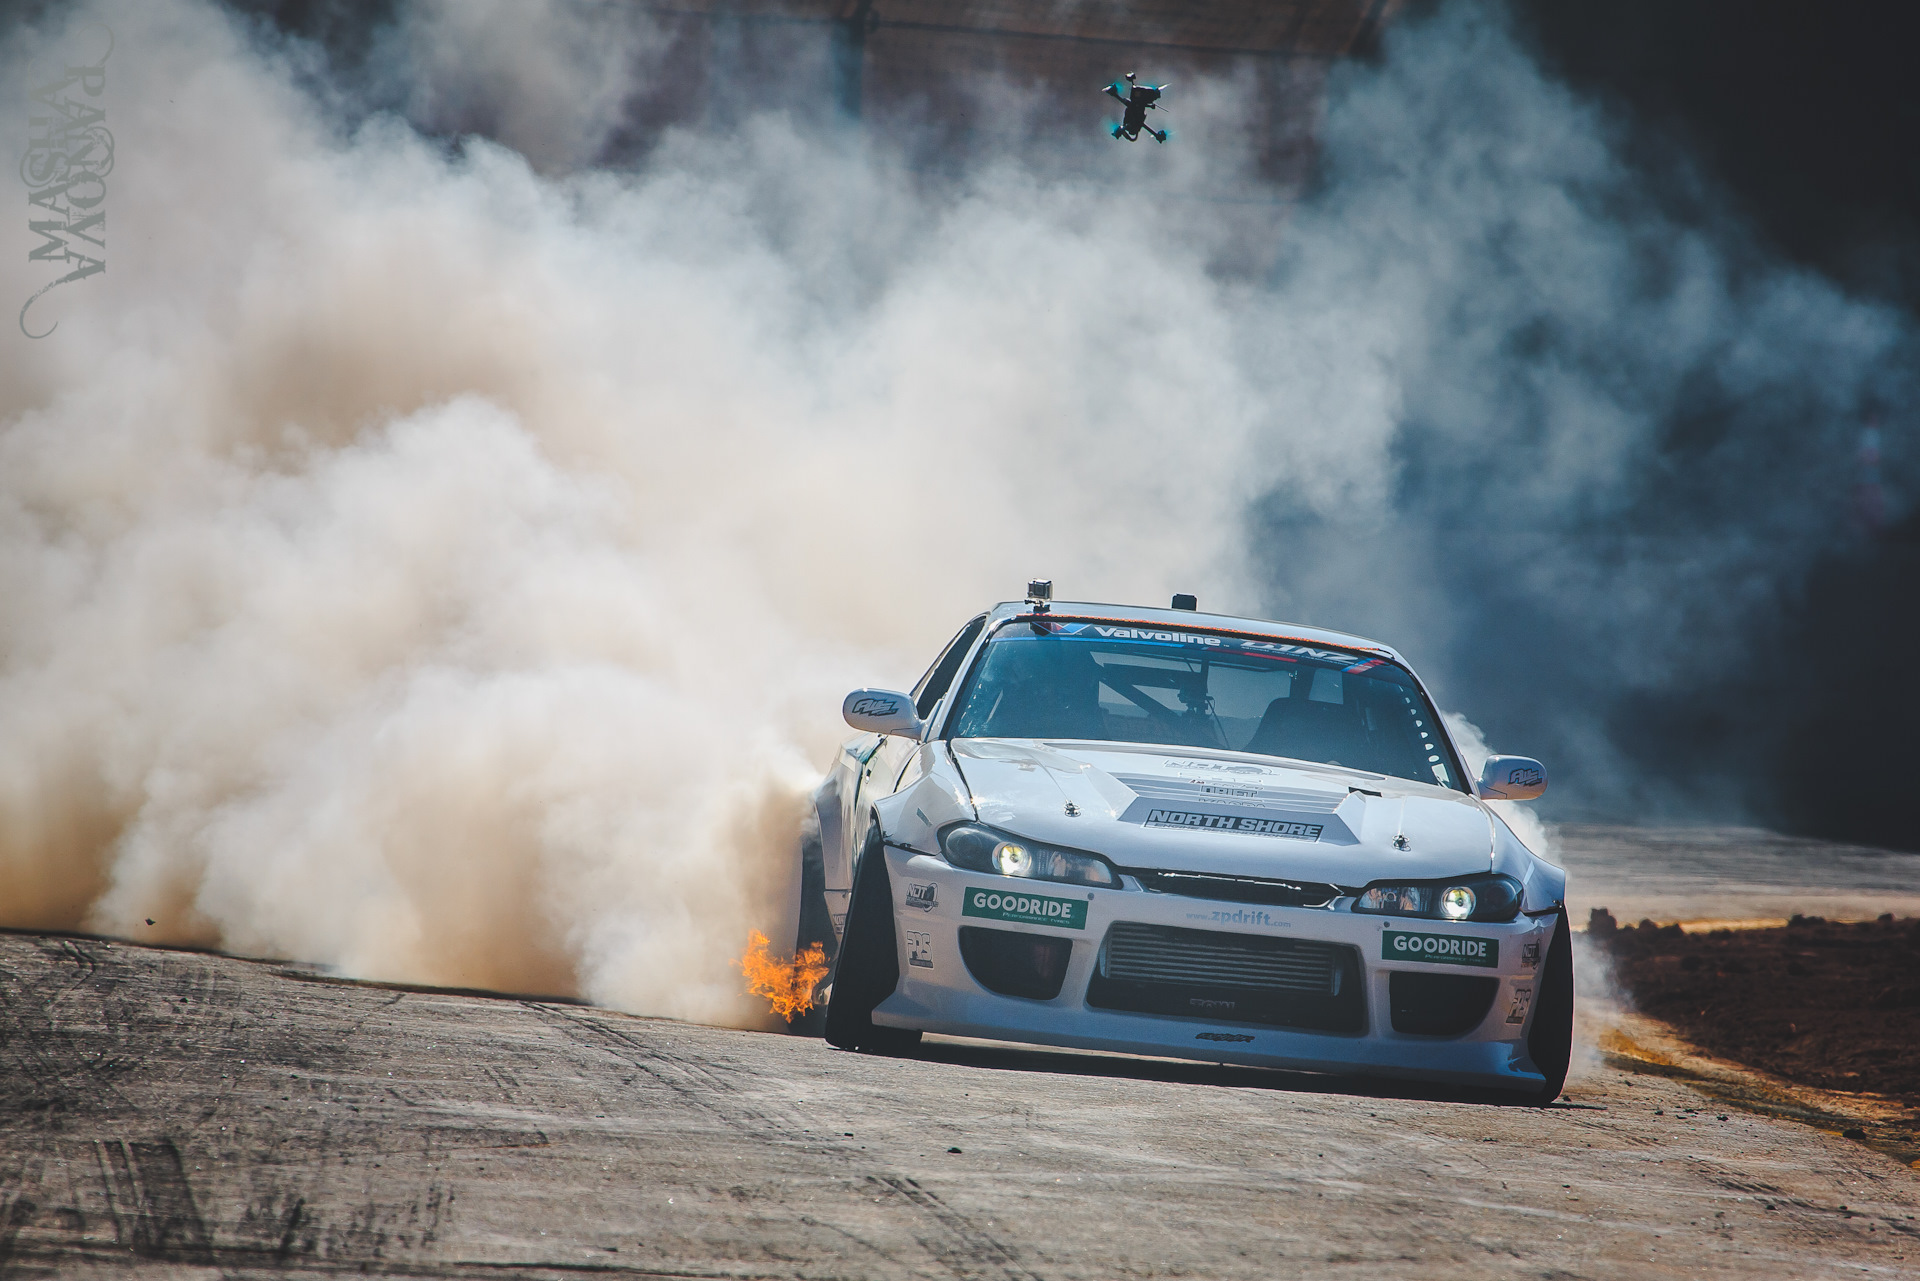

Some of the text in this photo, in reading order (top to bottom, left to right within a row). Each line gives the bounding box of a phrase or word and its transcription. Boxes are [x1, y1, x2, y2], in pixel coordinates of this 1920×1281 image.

[1094, 626, 1221, 647] Valvoline
[1149, 810, 1322, 838] NORTH SHORE
[973, 892, 1073, 919] GOODRIDE
[1186, 909, 1291, 928] www.zpdrift.com
[1393, 935, 1487, 957] GOODRIDE
